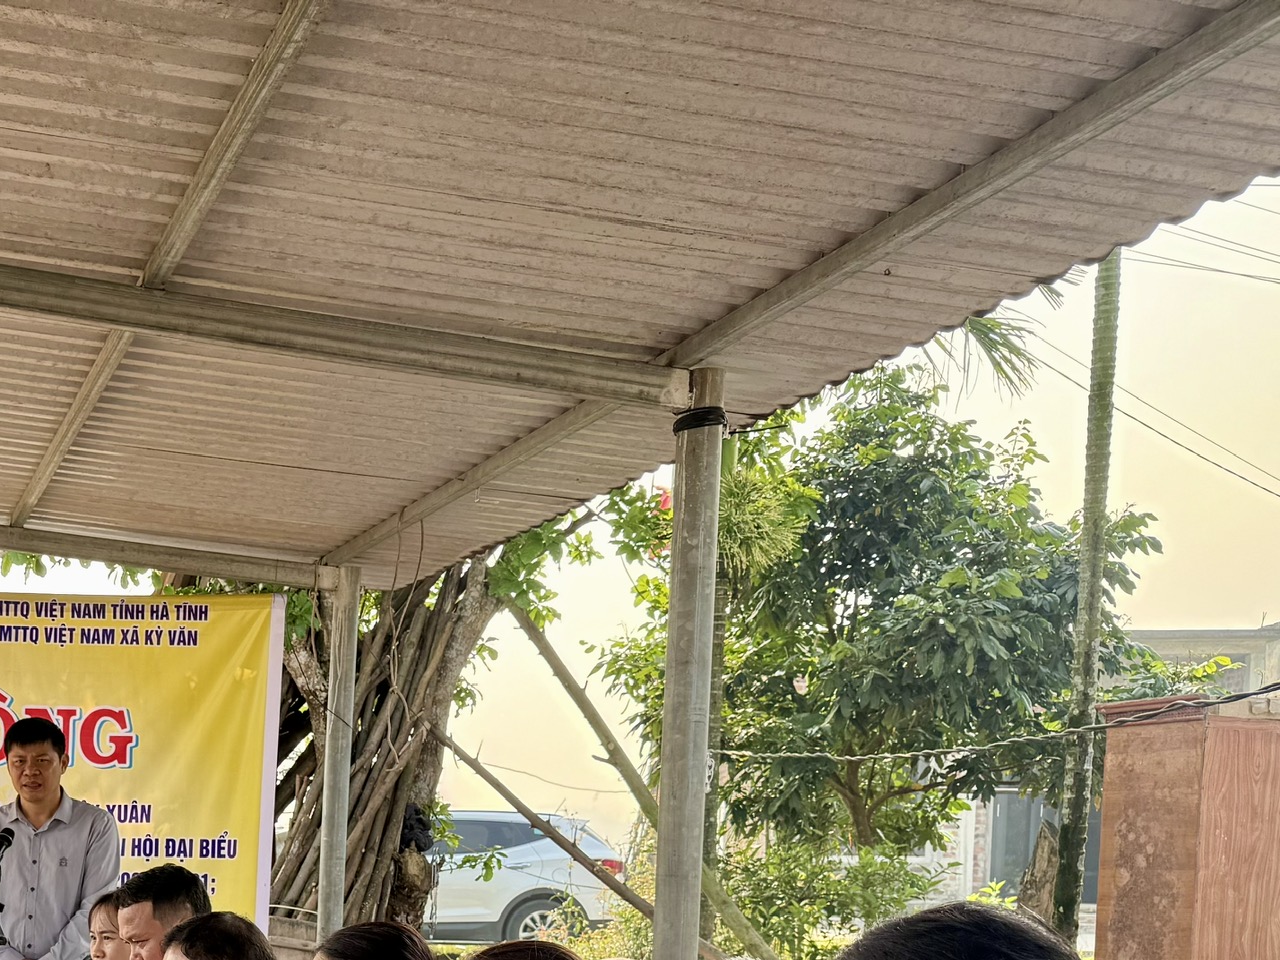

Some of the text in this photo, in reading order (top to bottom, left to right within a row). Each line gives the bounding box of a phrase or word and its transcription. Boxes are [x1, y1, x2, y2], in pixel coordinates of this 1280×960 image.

[35, 598, 66, 621] VIỆT
[71, 603, 106, 619] NAM
[111, 598, 145, 620] TỈNH
[150, 602, 169, 620] HÀ
[174, 602, 208, 621] TĨNH
[0, 625, 39, 644] MTTQ
[44, 624, 76, 647] VIỆT
[80, 628, 115, 644] NAM
[120, 626, 139, 645] XÃ
[145, 626, 163, 645] KỲ
[168, 626, 197, 646] VĂN
[131, 834, 159, 861] HỘI
[165, 839, 193, 862] ĐẠI
[200, 831, 237, 859] BIỂU
